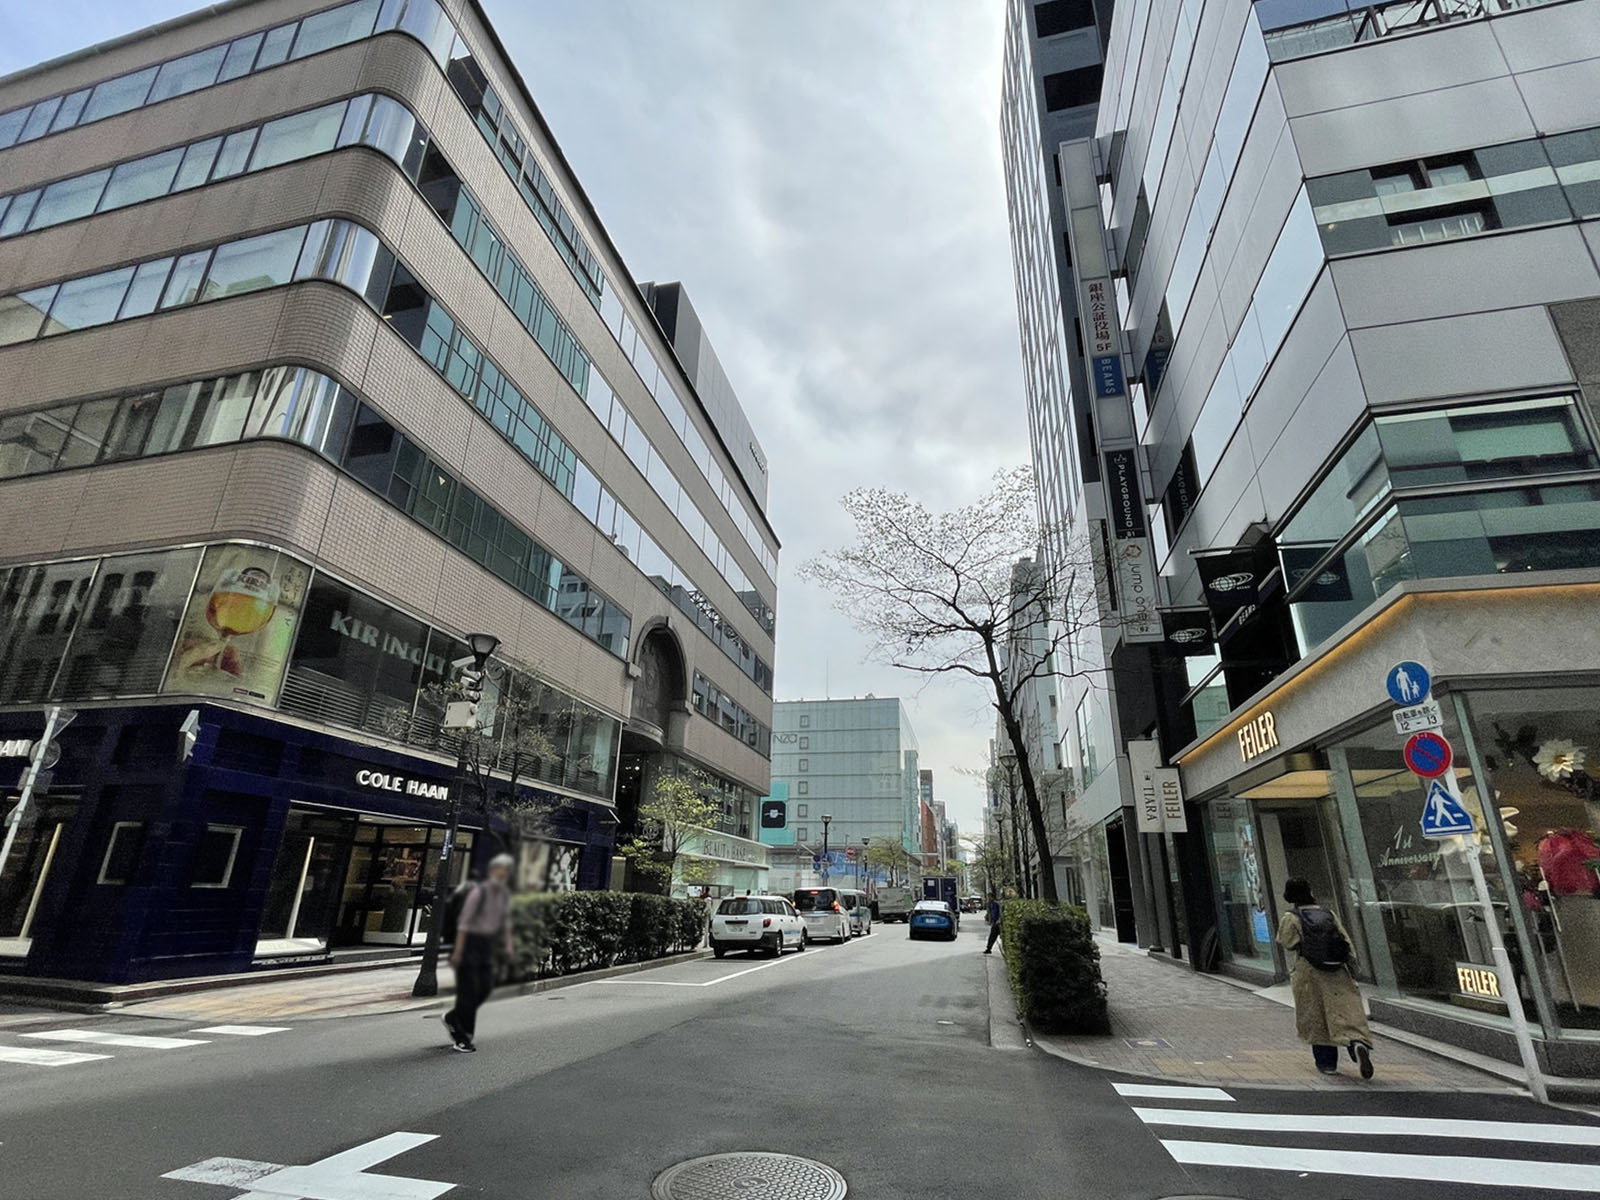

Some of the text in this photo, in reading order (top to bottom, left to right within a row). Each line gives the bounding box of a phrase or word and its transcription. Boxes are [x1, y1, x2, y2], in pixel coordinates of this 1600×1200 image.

[1088, 282, 1110, 341] 銀座公証役場
[1096, 342, 1112, 352] 5F
[1101, 358, 1116, 394] BEAMS
[1118, 464, 1134, 528] PLAYGROUND
[330, 609, 410, 661] KIRIN
[1237, 711, 1279, 763] FEILER
[1400, 721, 1410, 730] 12
[1426, 715, 1437, 725] 13
[0, 739, 33, 757] AN
[356, 769, 449, 801] COLE HAAN
[1143, 784, 1158, 821] TIARA
[1162, 781, 1181, 819] FEILER
[1457, 967, 1500, 997] FEILER
